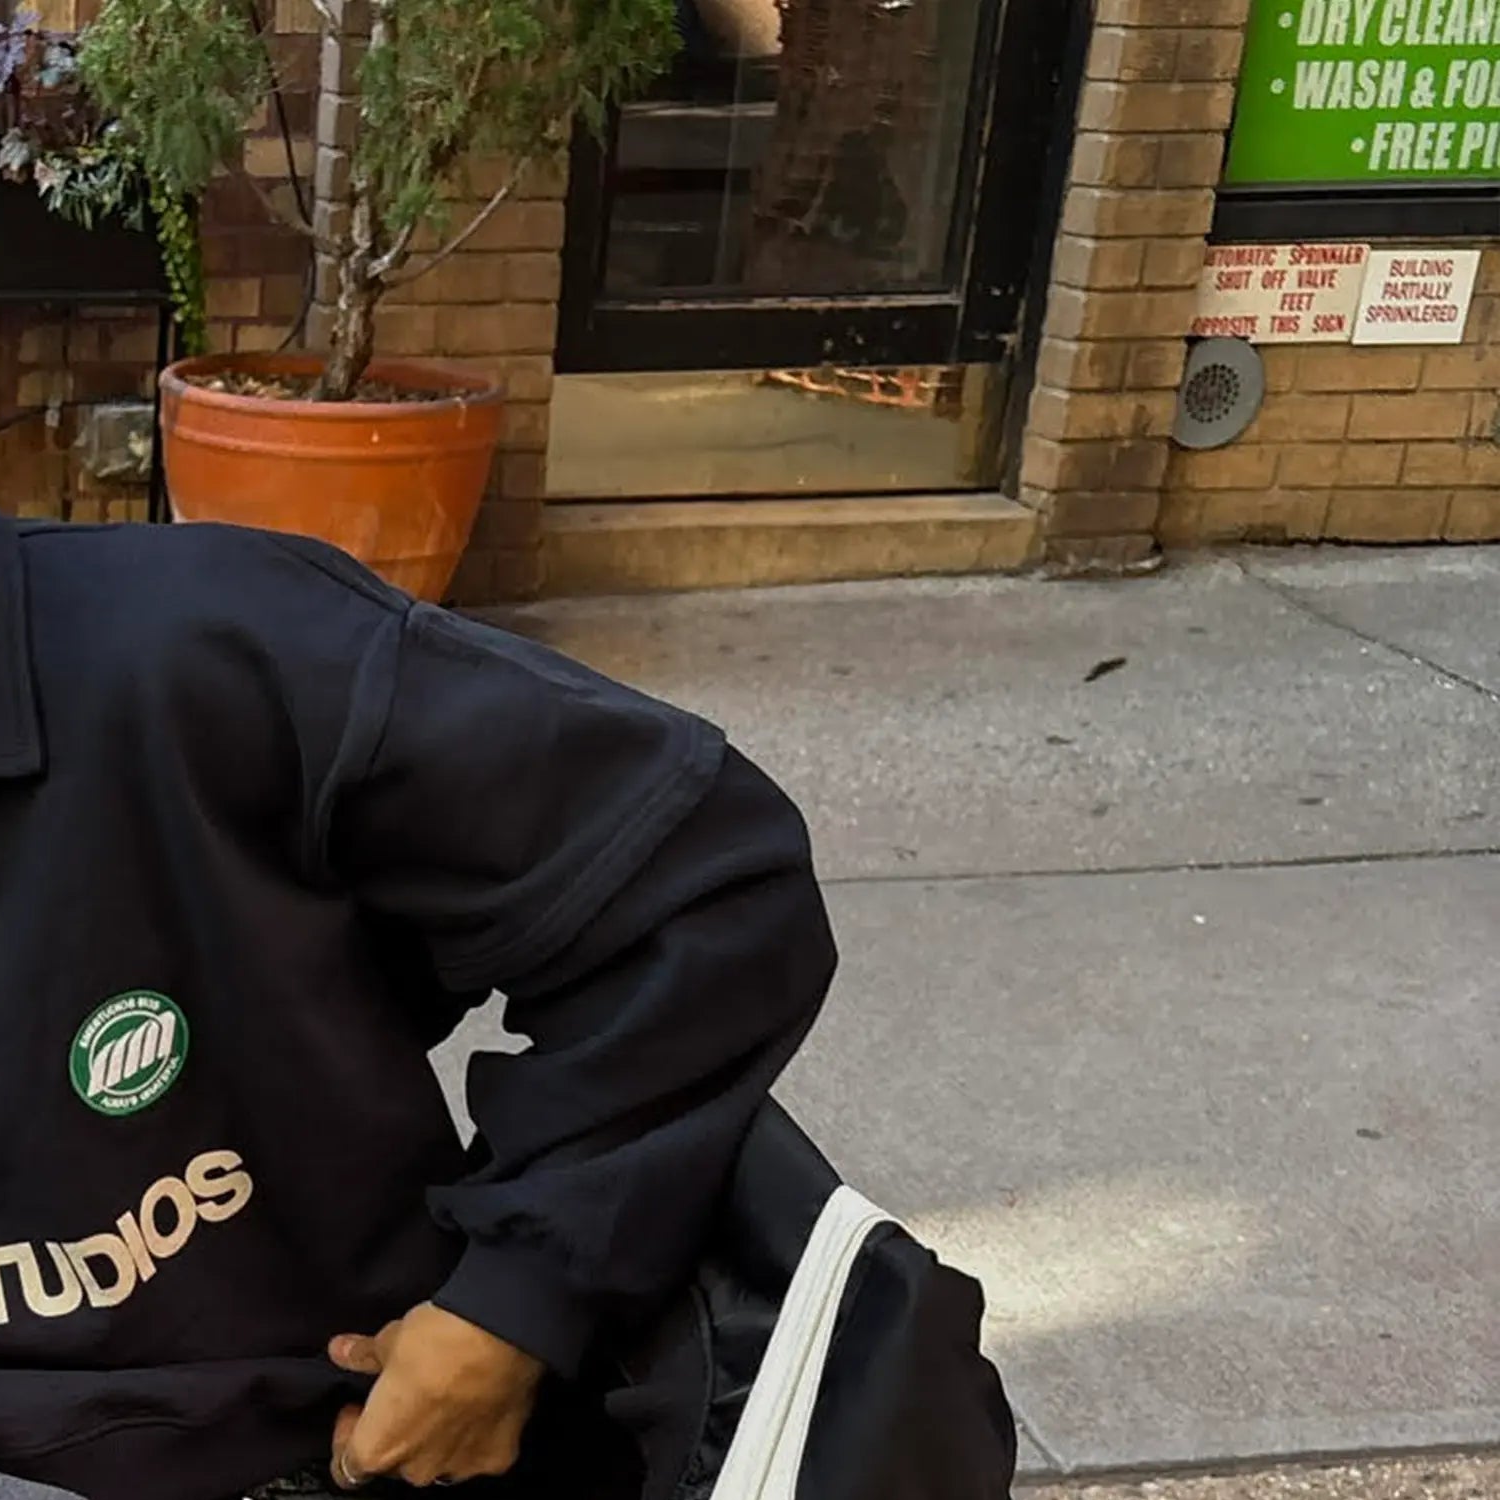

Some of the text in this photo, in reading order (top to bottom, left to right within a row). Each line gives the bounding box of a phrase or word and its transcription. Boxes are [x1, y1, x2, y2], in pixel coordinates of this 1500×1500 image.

[1297, 0, 1376, 46] DRY
[1293, 60, 1407, 110] WASH
[1410, 66, 1436, 109] &
[1368, 122, 1457, 171] FREE
[1288, 246, 1363, 265] SPRINKLER
[1389, 259, 1454, 277] BUILDING
[1215, 269, 1339, 290] SHUT OFF VALVE
[1381, 282, 1452, 300] PARTIALLY
[1280, 293, 1315, 311] FEET
[1365, 304, 1458, 323] SPRINKLERED
[1191, 315, 1346, 335] OPPOSITE THIS SIGN
